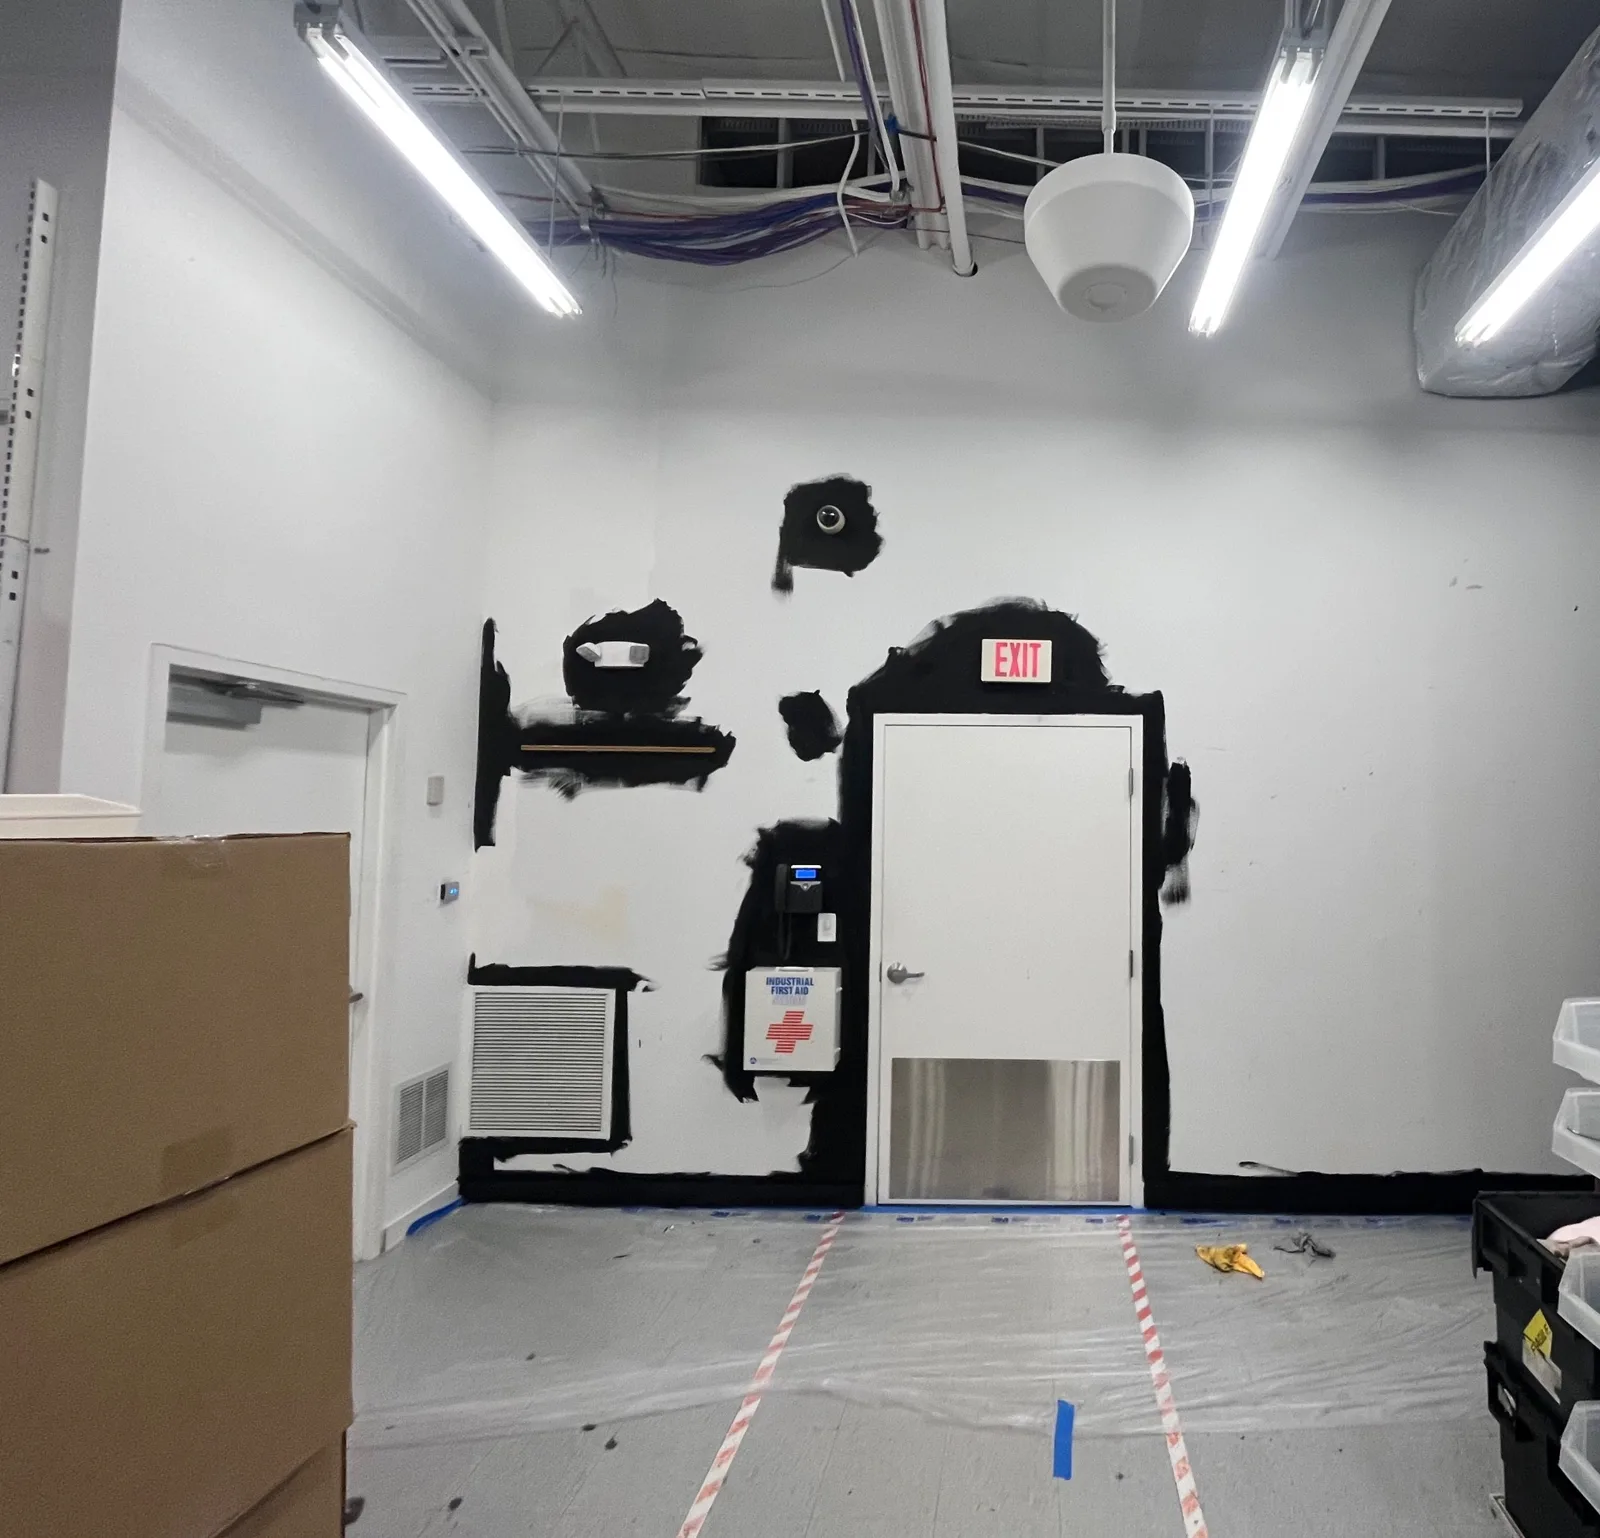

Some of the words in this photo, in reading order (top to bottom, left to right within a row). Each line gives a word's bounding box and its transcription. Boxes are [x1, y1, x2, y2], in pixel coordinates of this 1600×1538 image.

[995, 642, 1042, 678] EXIT
[766, 977, 814, 986] INDUSTRIAL
[771, 986, 792, 995] FIRST
[795, 986, 809, 995] AID
